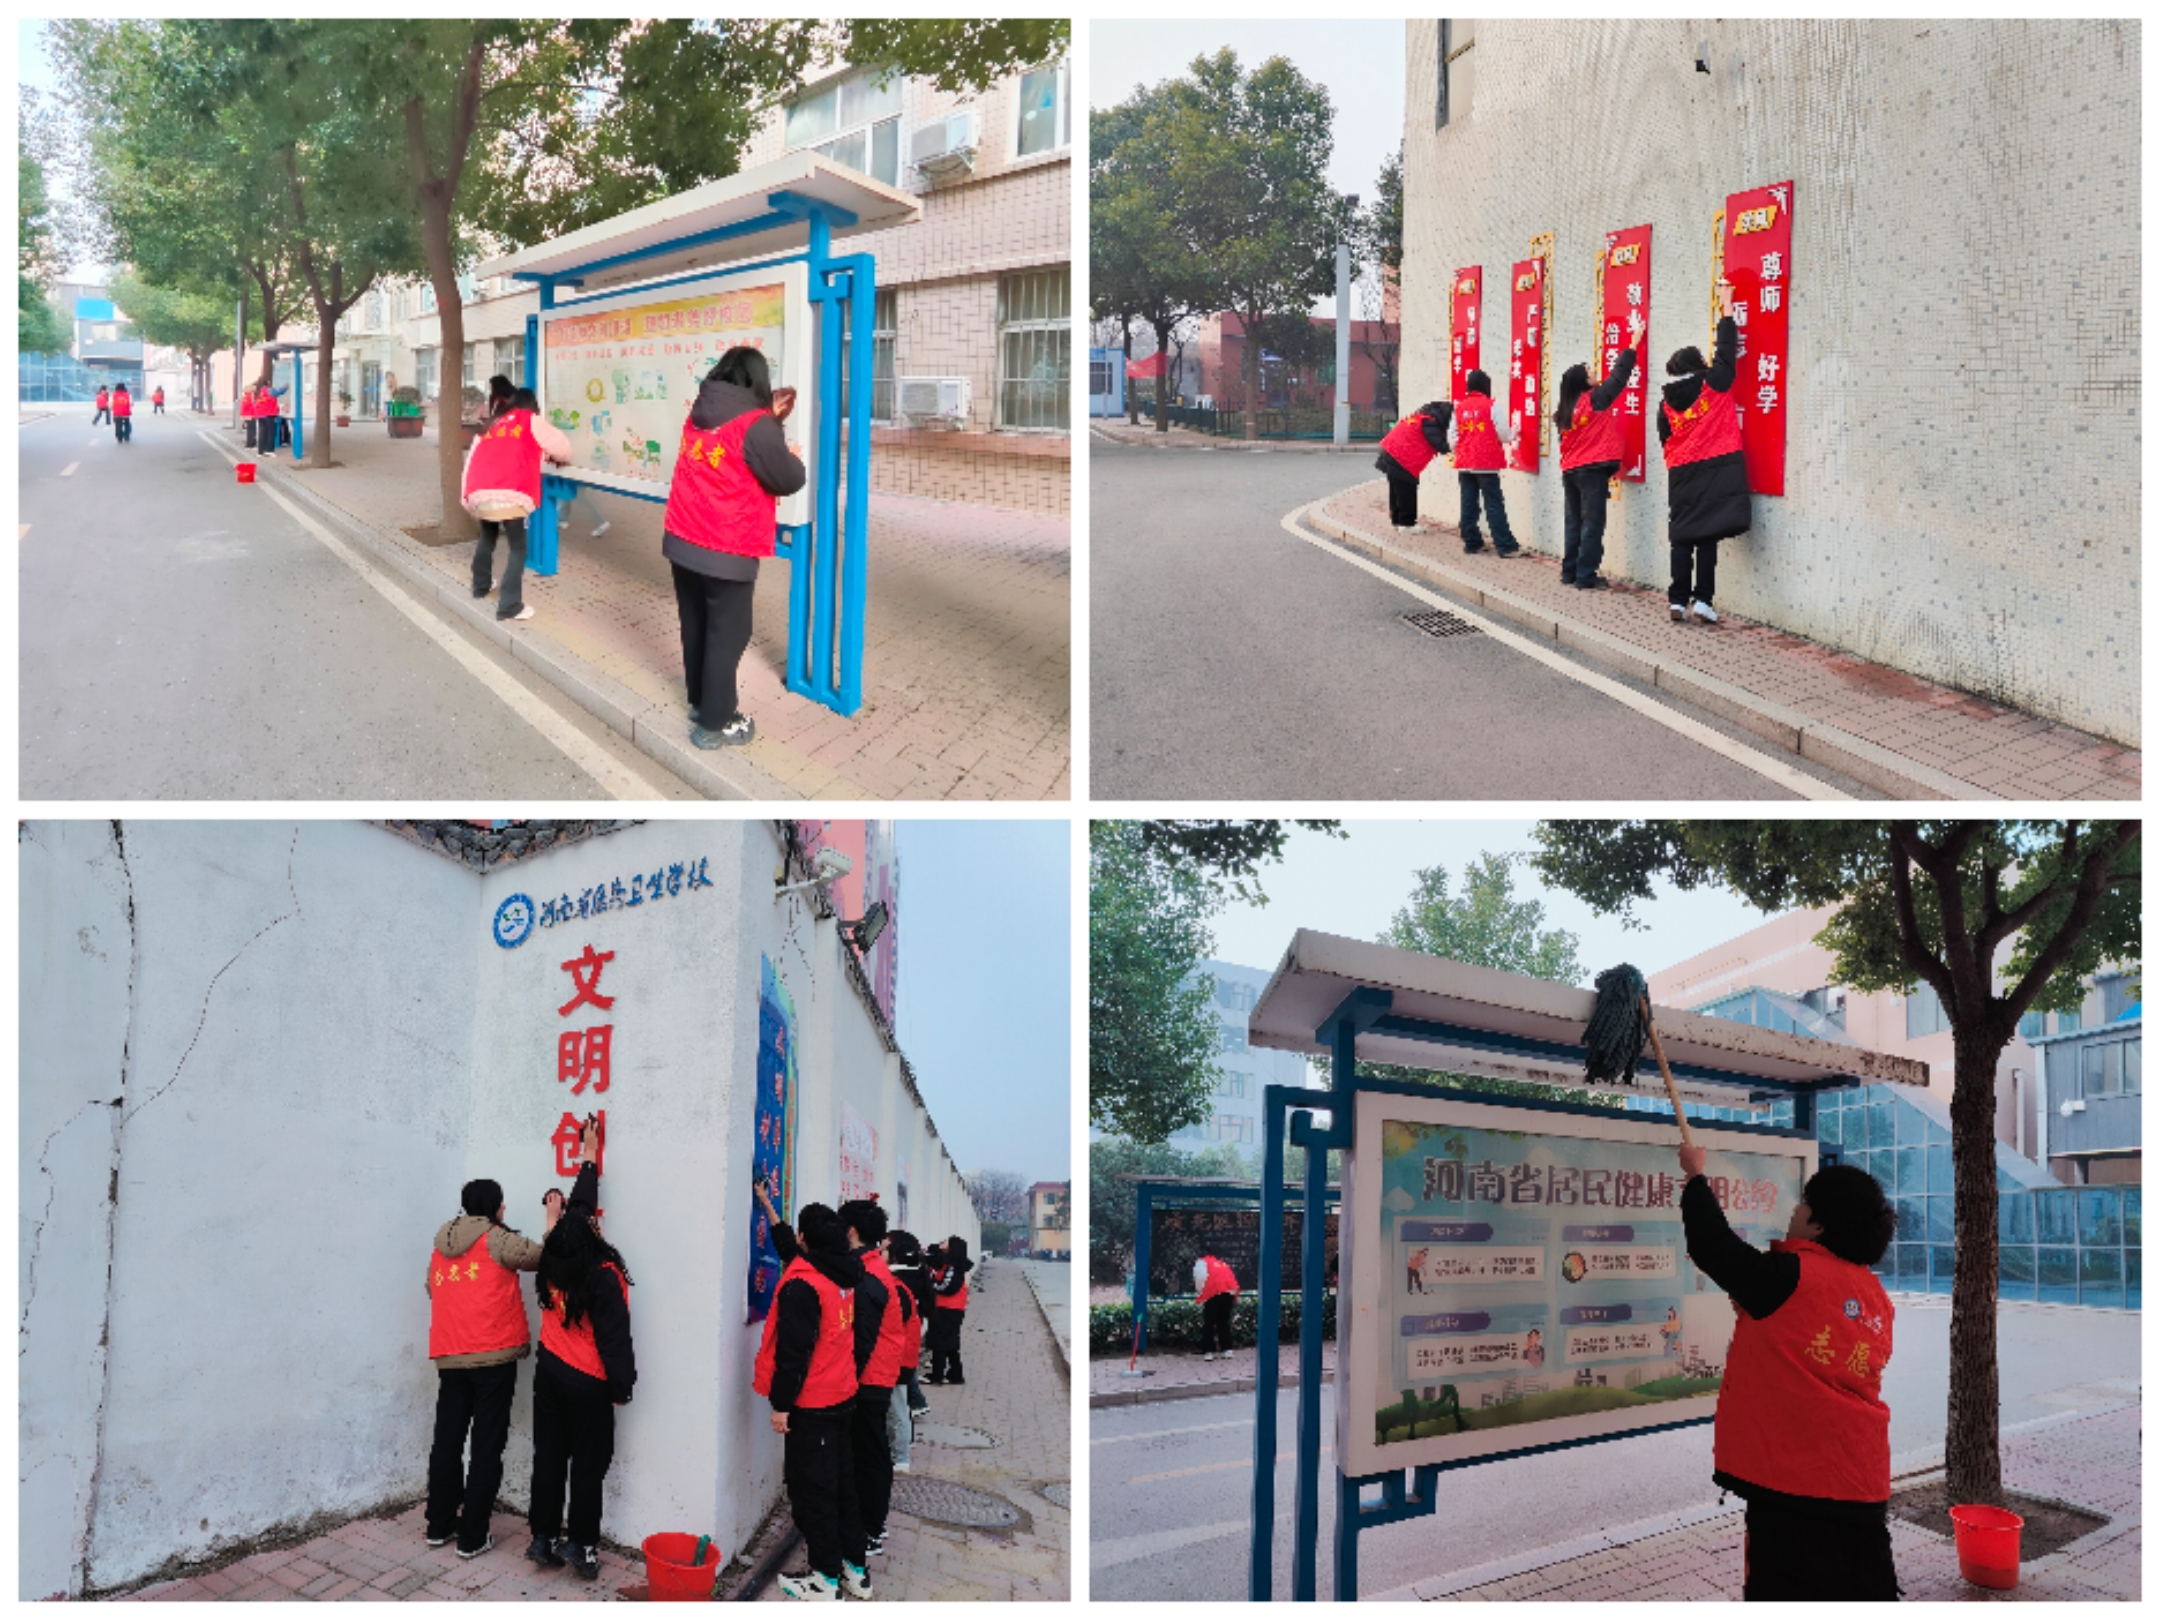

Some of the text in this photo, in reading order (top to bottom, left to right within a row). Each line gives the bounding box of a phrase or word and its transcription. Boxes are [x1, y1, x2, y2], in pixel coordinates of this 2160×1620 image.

[1756, 252, 1782, 414] 尊师 好学
[550, 944, 615, 1217] 文明创
[1804, 1324, 1886, 1380] 志愿
